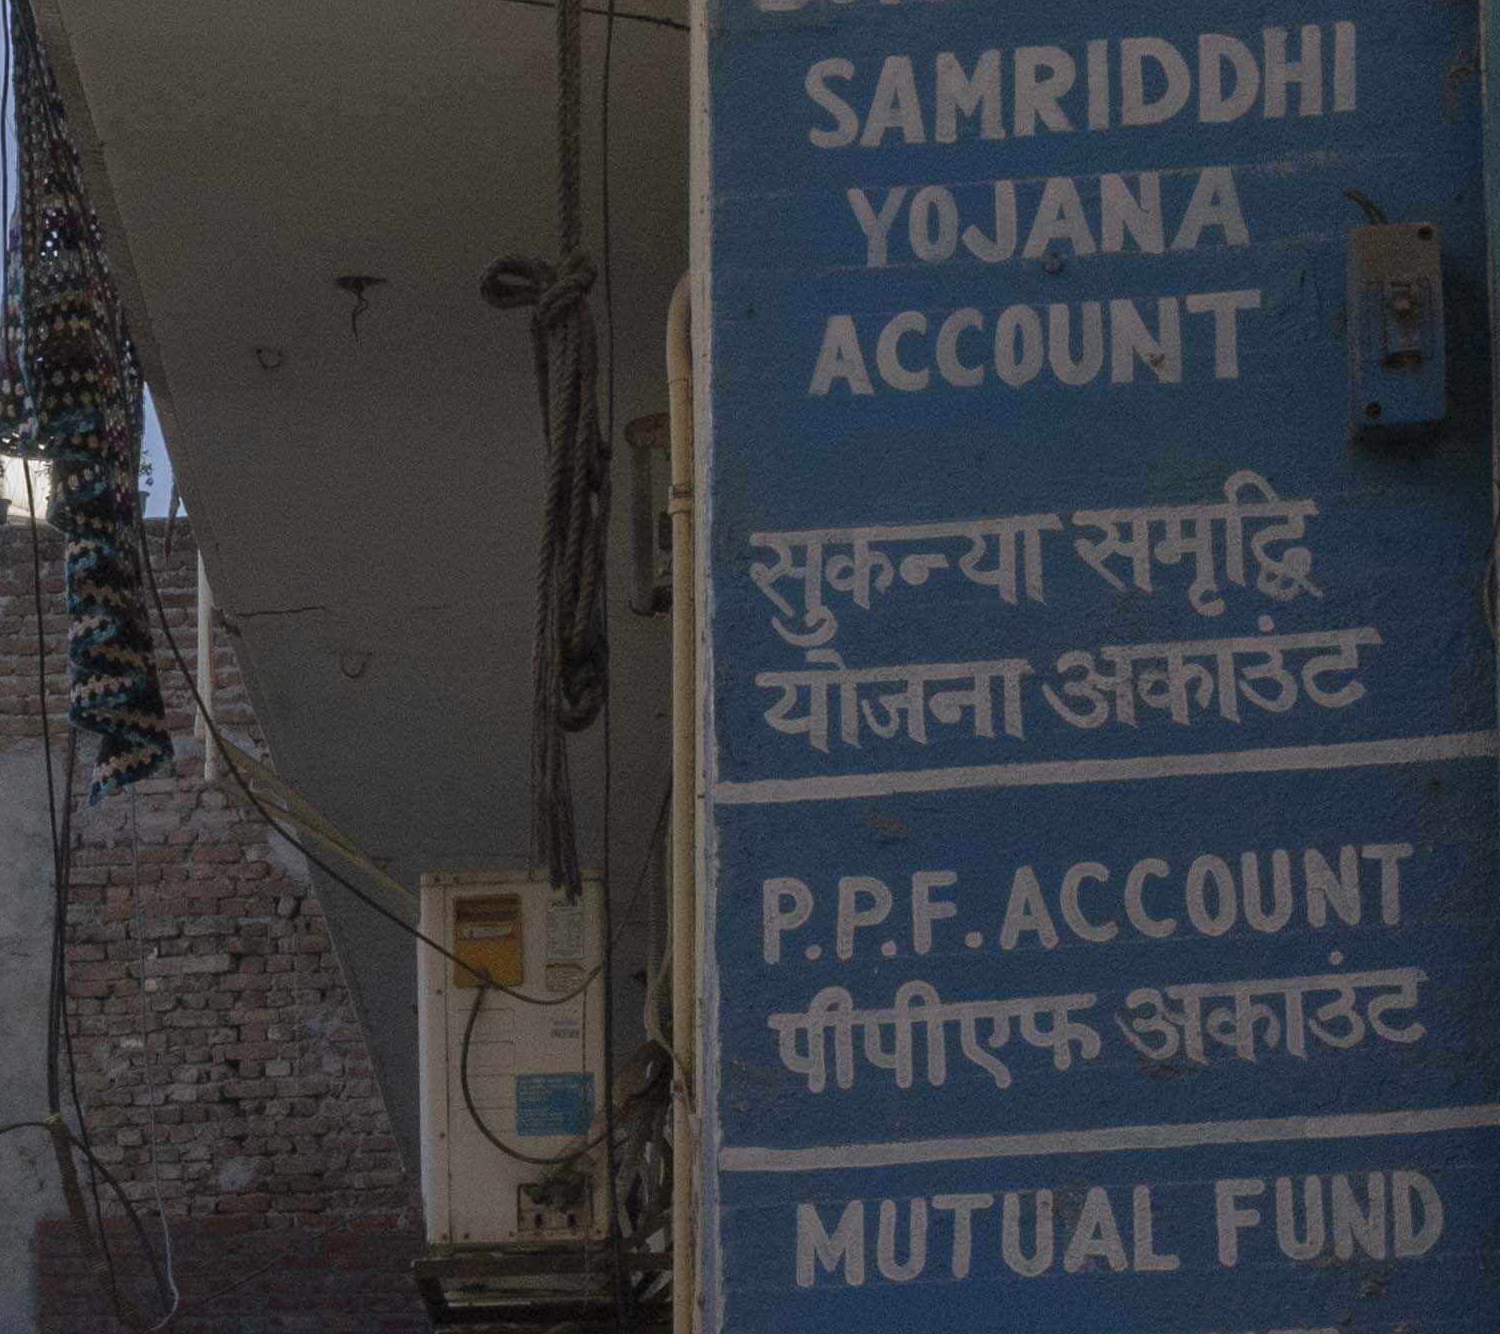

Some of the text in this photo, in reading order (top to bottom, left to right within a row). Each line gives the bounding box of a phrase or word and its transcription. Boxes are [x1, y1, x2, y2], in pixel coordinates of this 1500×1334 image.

[804, 21, 1357, 150] SAMRIDDHI
[847, 166, 1252, 269] YOJANA
[809, 289, 1261, 396] ACCOUNT
[750, 513, 1063, 648] सुकन्या
[756, 615, 1383, 753] योजना अकाउंट
[768, 951, 1430, 1094] पीपीएफ अकाउंट
[794, 1169, 1444, 1288] MUTUAL FUND
